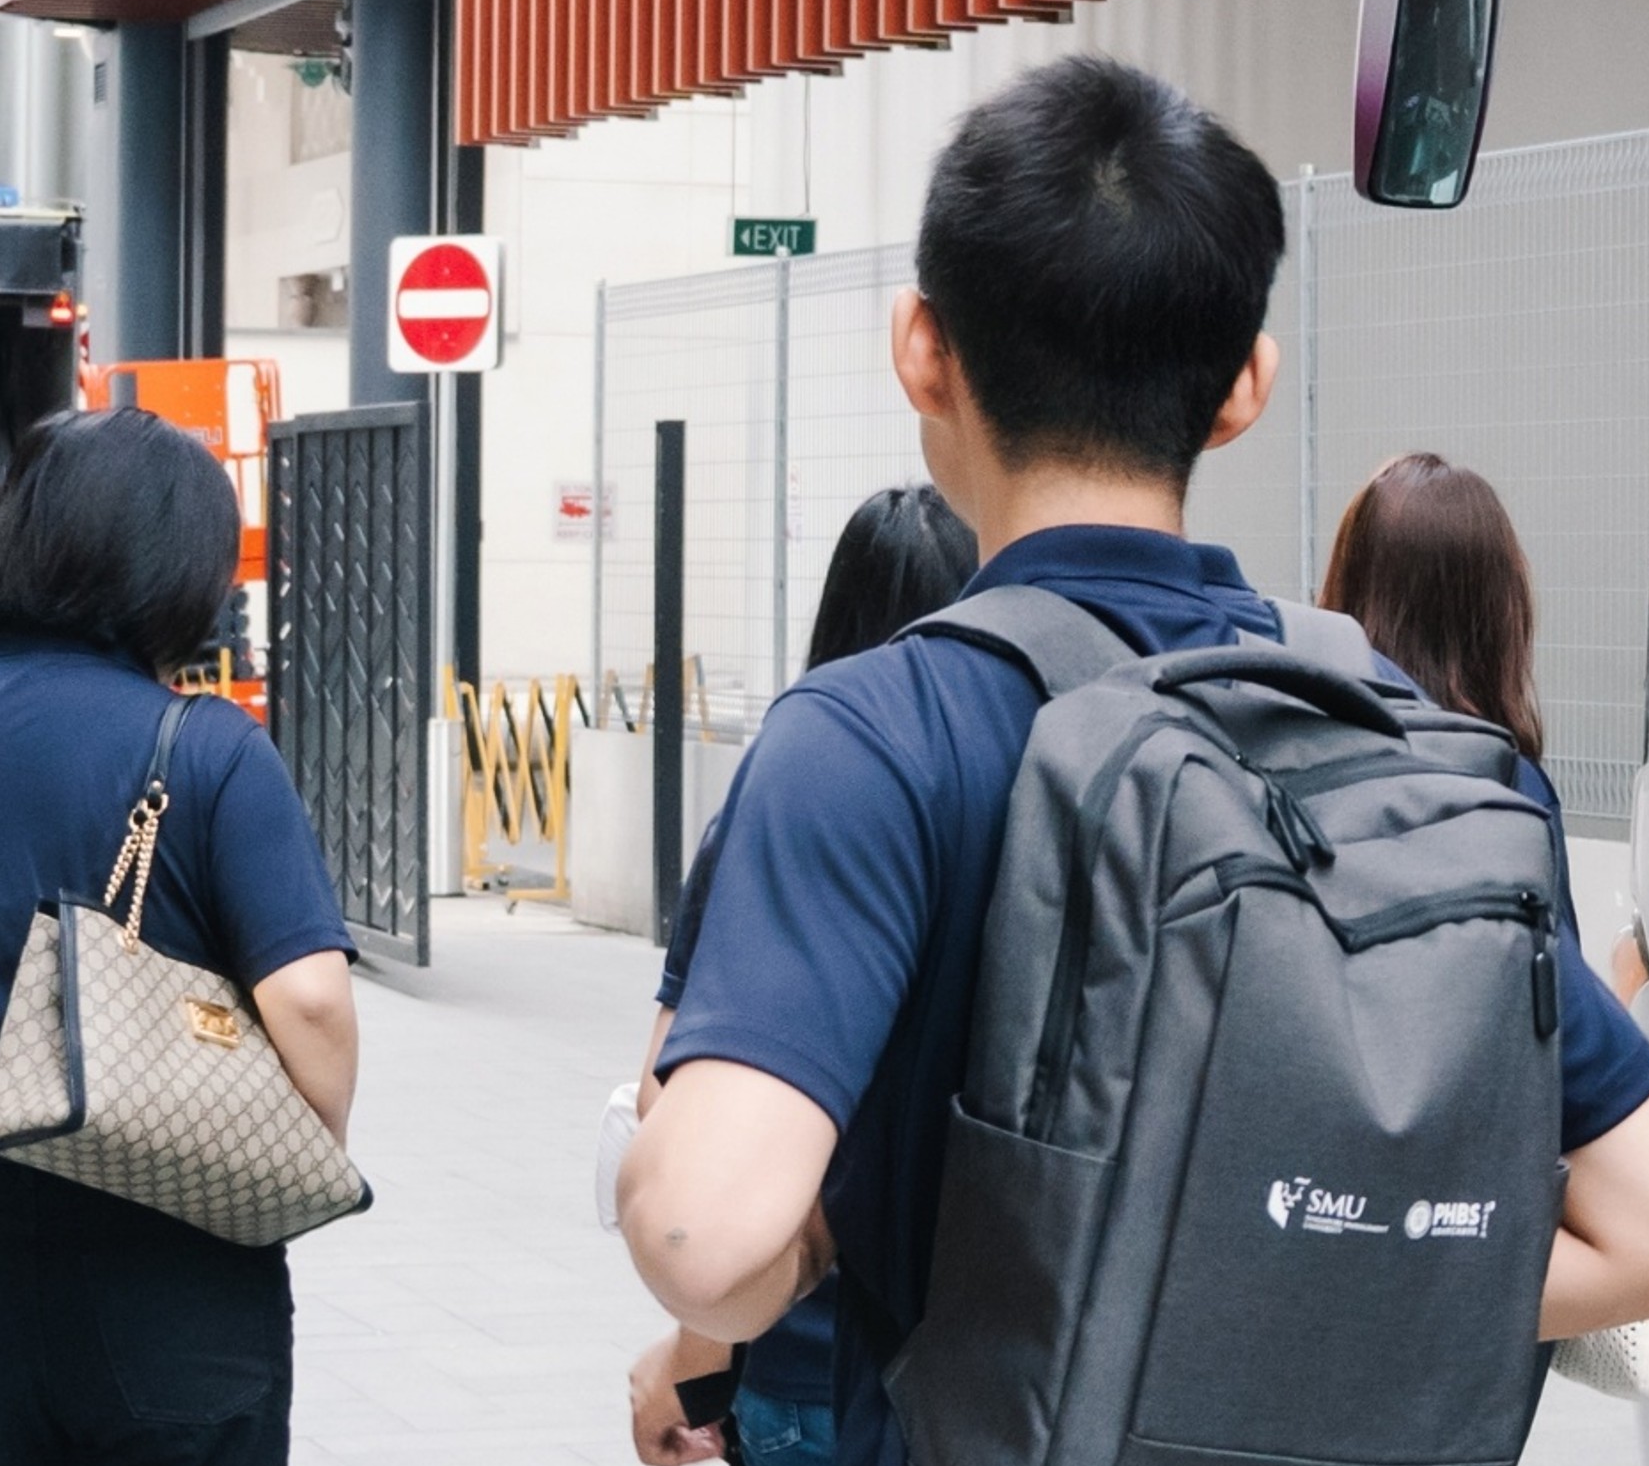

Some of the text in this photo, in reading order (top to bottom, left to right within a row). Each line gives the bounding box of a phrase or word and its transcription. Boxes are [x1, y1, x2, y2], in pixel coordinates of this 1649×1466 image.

[753, 224, 802, 251] EXIT
[1305, 1187, 1368, 1220] SMU
[1432, 1201, 1482, 1227] PHBS
